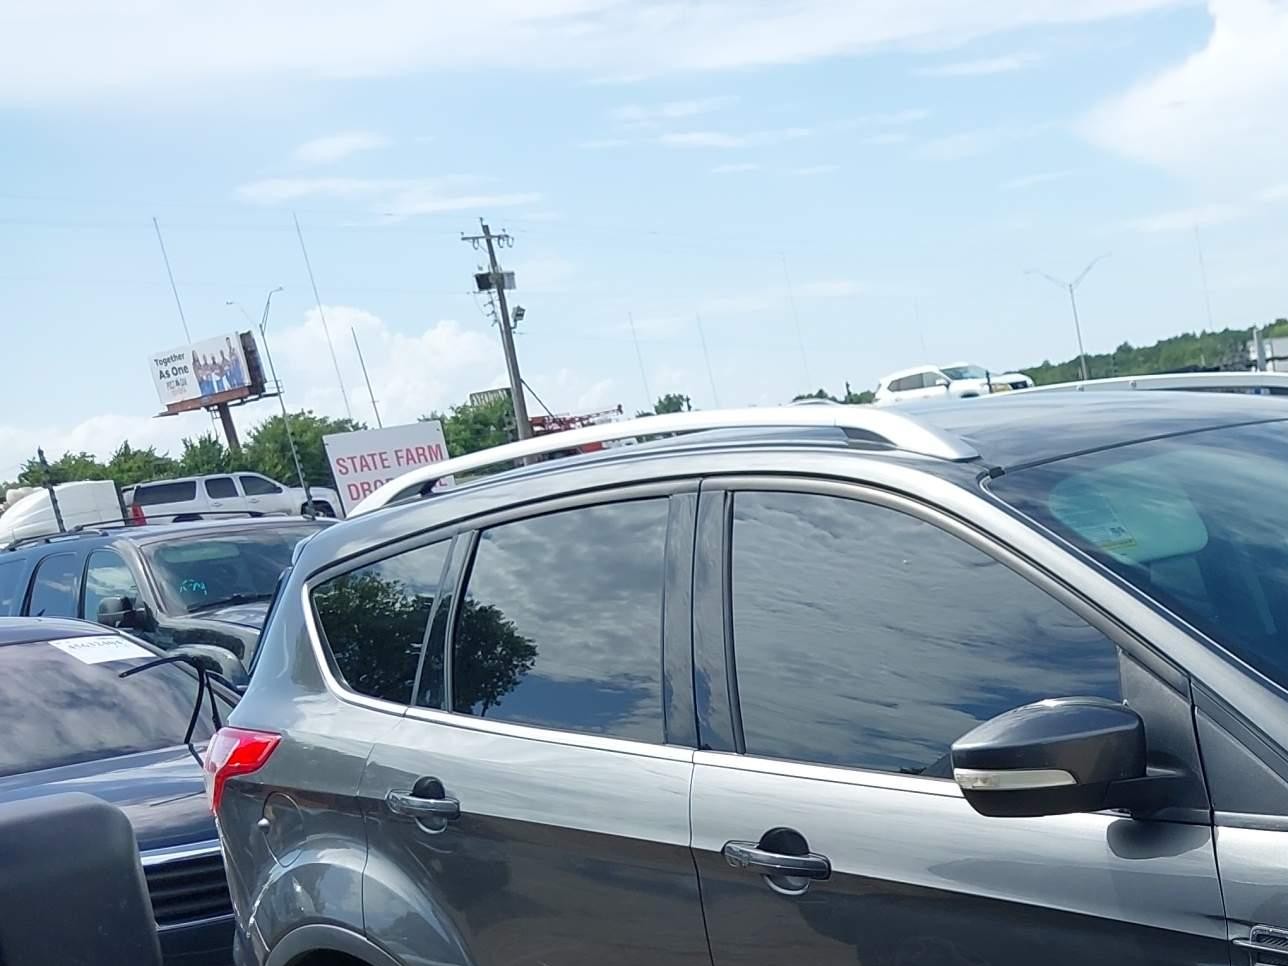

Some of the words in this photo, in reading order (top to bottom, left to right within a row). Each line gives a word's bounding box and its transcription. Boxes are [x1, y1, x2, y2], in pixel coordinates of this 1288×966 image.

[153, 352, 185, 367] Together
[159, 369, 171, 380] As
[171, 365, 189, 376] One
[335, 451, 391, 475] STATE
[394, 443, 444, 467] FARM
